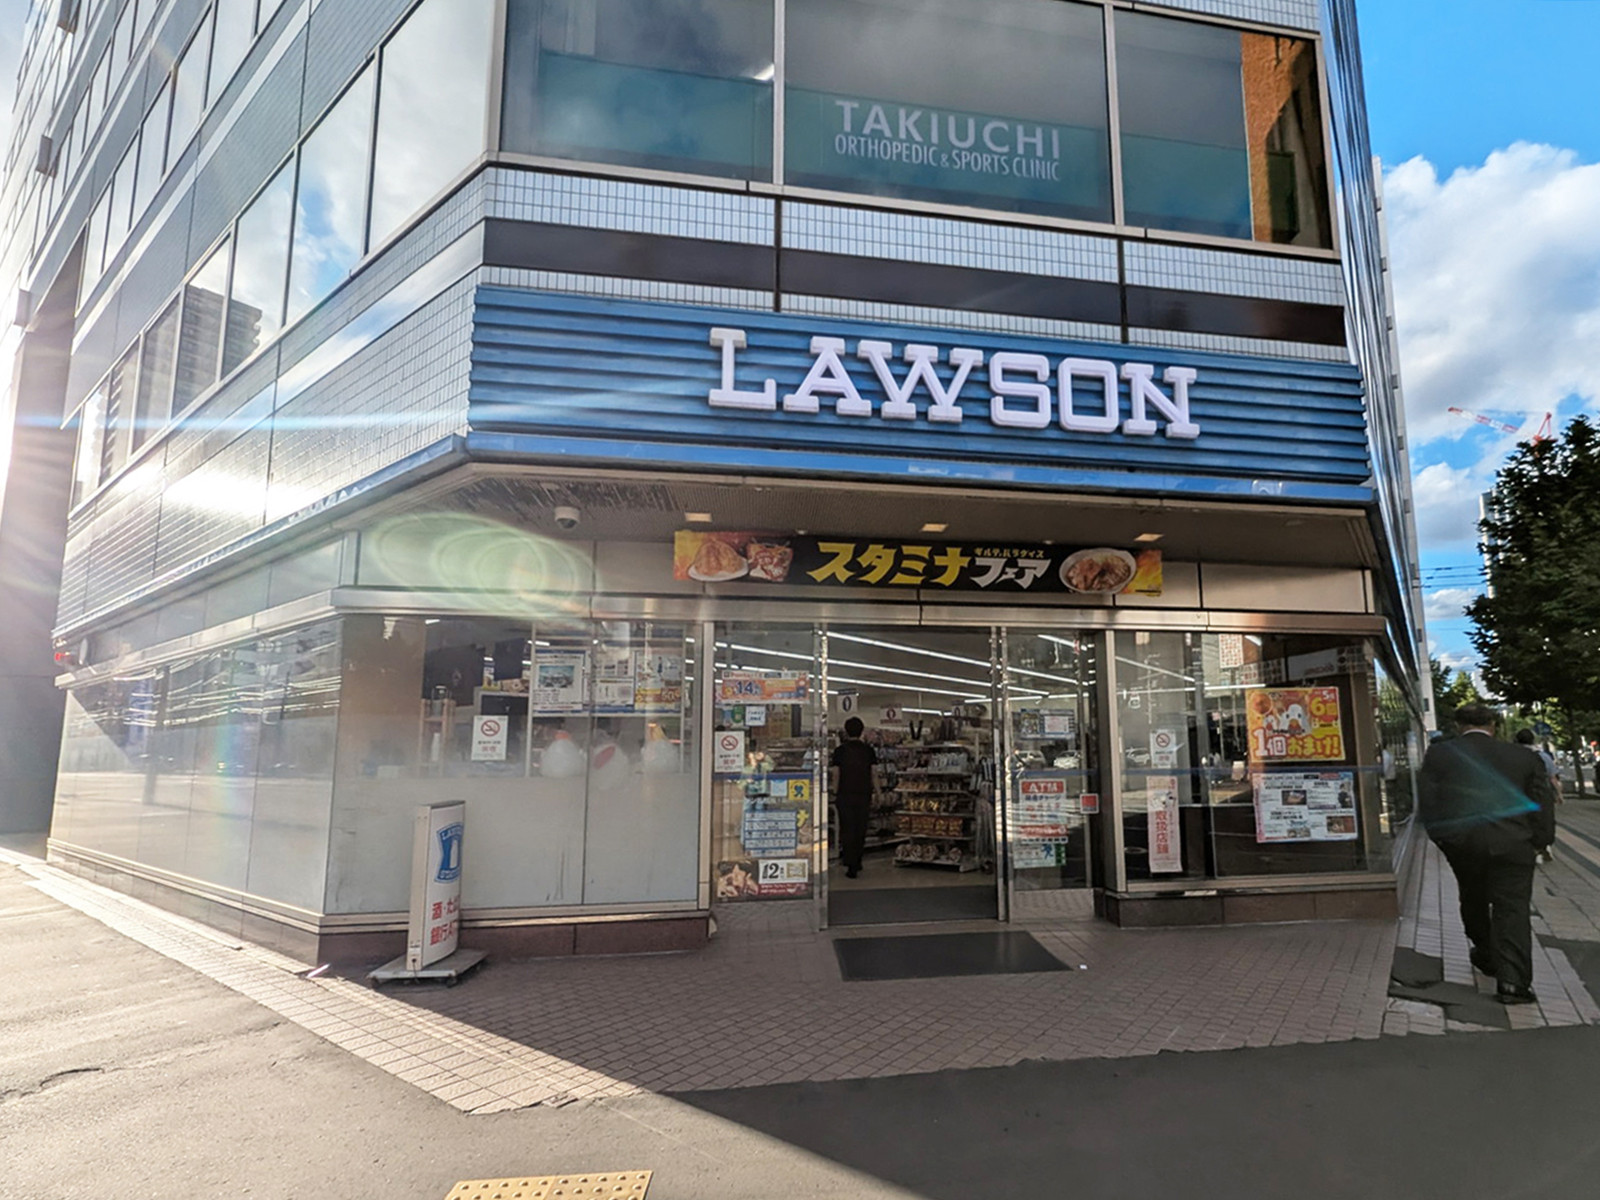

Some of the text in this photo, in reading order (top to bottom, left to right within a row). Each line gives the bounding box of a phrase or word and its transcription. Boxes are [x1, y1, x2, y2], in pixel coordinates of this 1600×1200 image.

[835, 101, 1060, 159] TAKIUCHI
[835, 134, 1061, 182] ORTHOPEDIC & SPORTS CLINIC
[709, 327, 1200, 440] LAWSON
[1028, 783, 1058, 793] ATM
